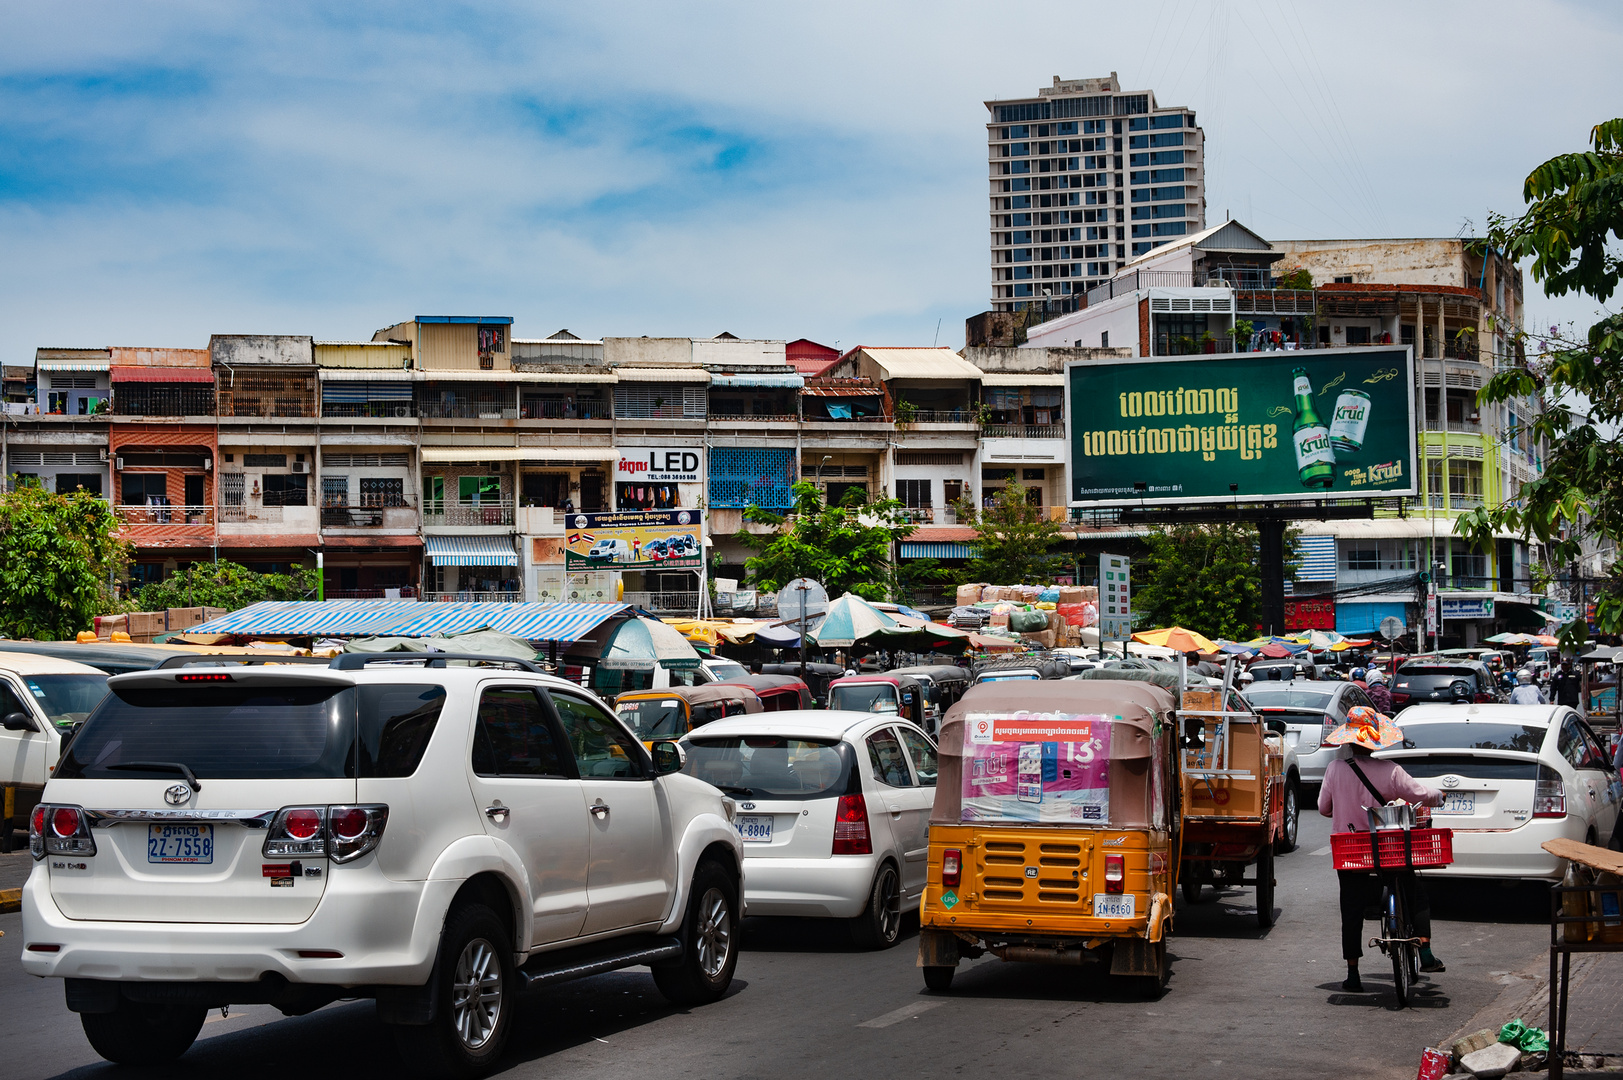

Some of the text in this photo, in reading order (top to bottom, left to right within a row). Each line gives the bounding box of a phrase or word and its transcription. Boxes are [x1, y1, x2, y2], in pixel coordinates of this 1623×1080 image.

[1119, 387, 1238, 423] ពេលវេលាល្អ
[1335, 405, 1365, 421] Krud
[1083, 423, 1277, 461] ពេលវេលាជាមួយគ្រុឌ
[1299, 434, 1330, 457] Krud
[619, 457, 648, 474] អំពូល
[650, 452, 699, 472] LED
[1368, 460, 1402, 482] Krud
[1344, 468, 1361, 476] GOOD
[114, 810, 238, 819] FORTUNER
[162, 825, 199, 837] ភ្នំពេញ
[150, 837, 211, 856] 2Z-7558
[1097, 904, 1131, 915] 1N-6160
